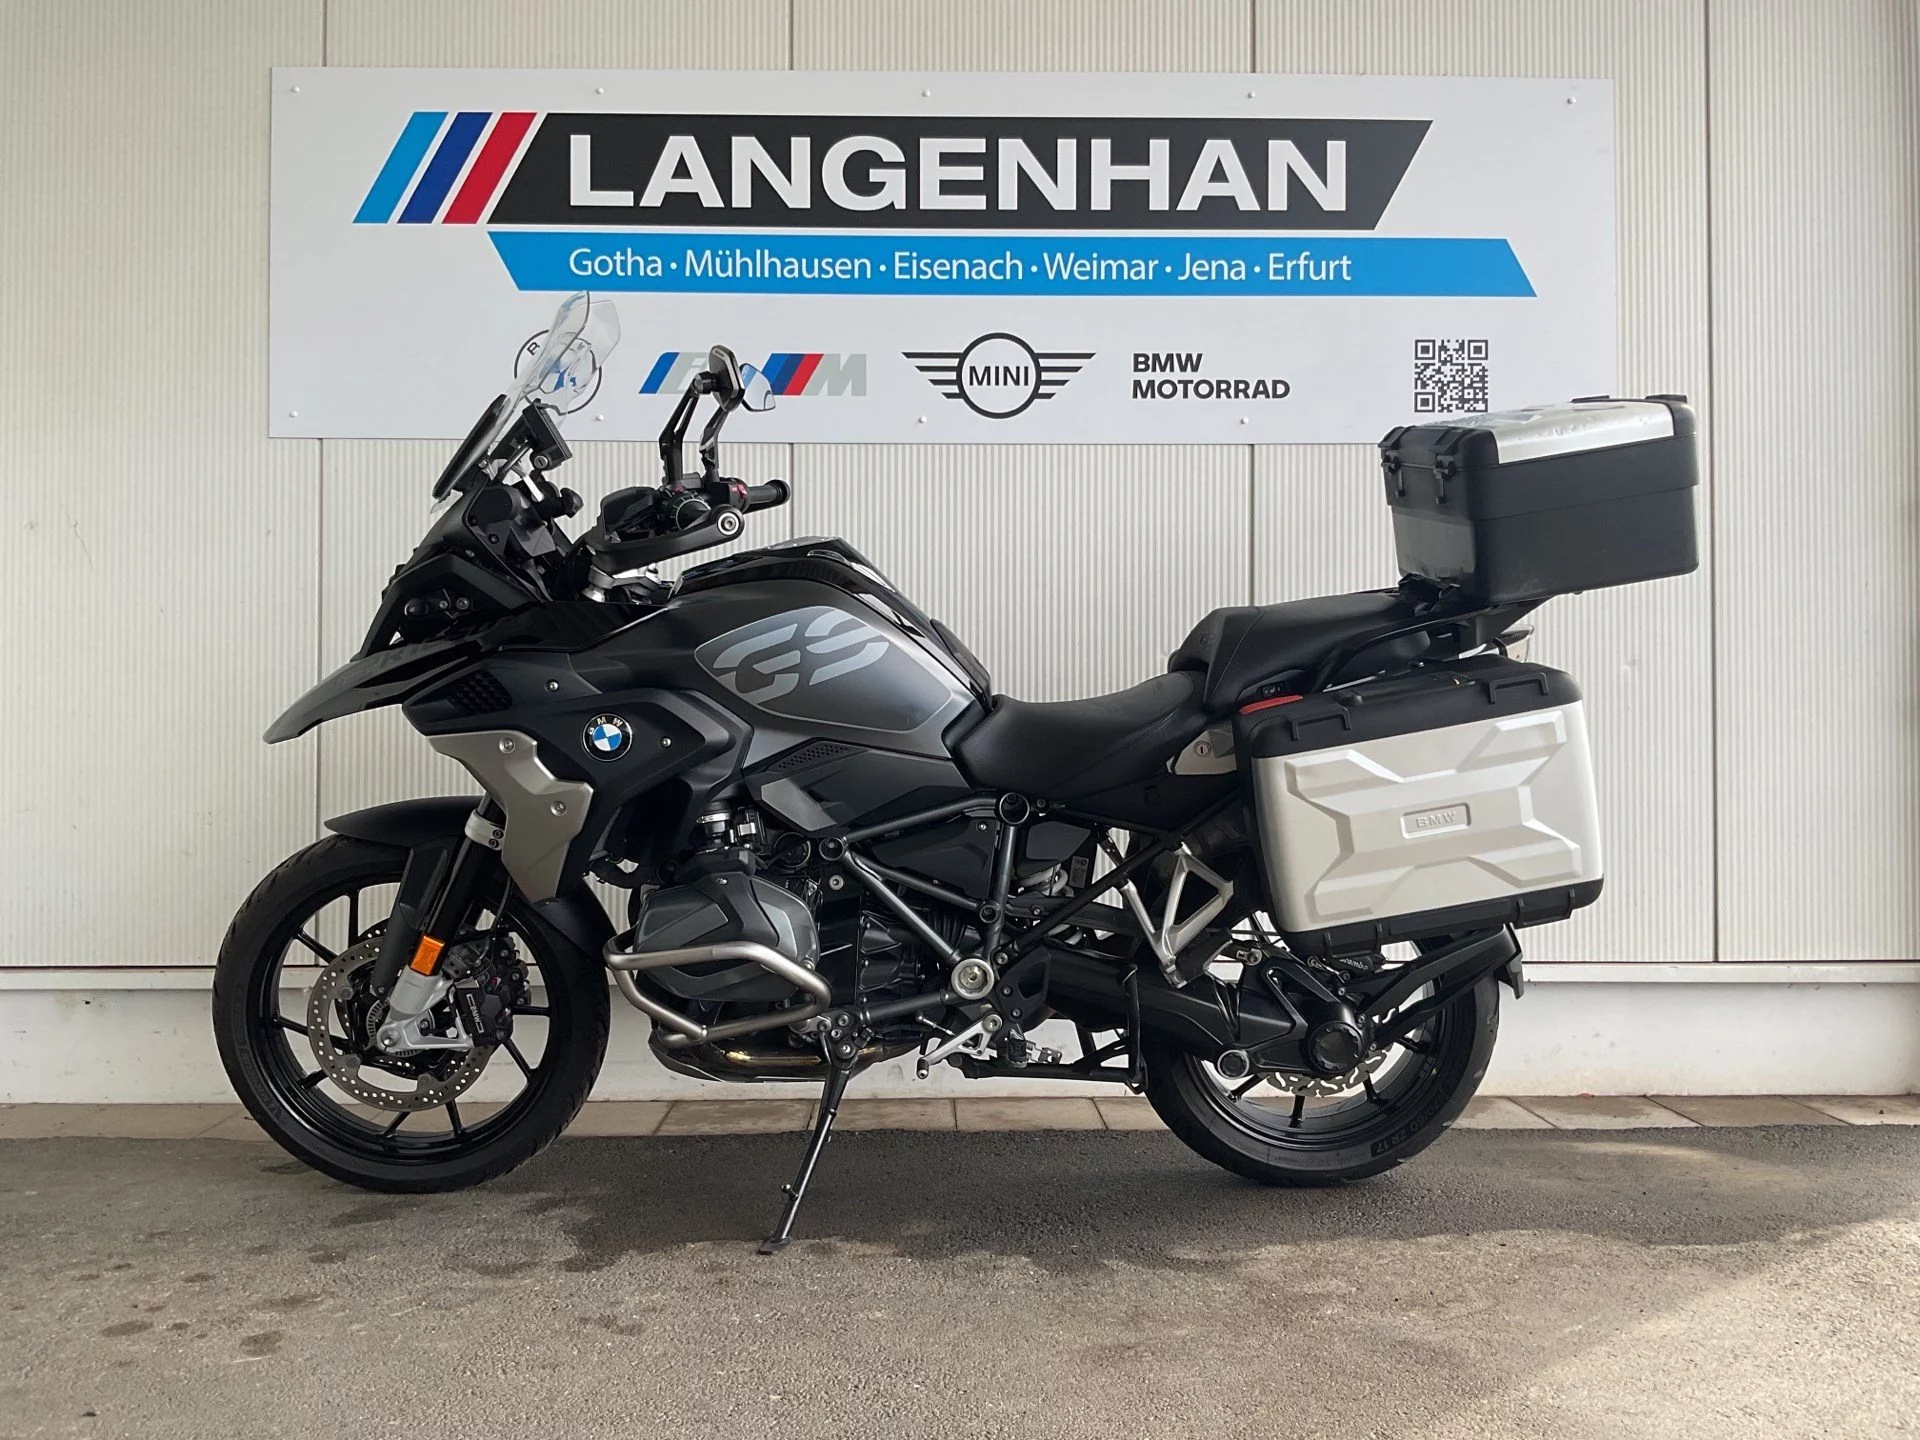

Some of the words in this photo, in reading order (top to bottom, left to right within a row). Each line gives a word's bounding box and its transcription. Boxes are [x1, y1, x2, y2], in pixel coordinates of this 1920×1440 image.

[570, 134, 1346, 212] LANGENHAN
[569, 247, 661, 277] Gotha
[685, 248, 870, 279] Mühlhausen
[894, 250, 1022, 280] Eisenach
[1043, 251, 1158, 281] Weimar
[1177, 252, 1245, 281] Jena
[1269, 251, 1351, 281] Erfurt
[1133, 352, 1202, 372] BMW
[969, 365, 1029, 387] MINI
[1132, 379, 1290, 400] MOTORRAD
[713, 608, 889, 705] GS
[587, 716, 623, 735] BMW
[1415, 810, 1456, 828] BMW
